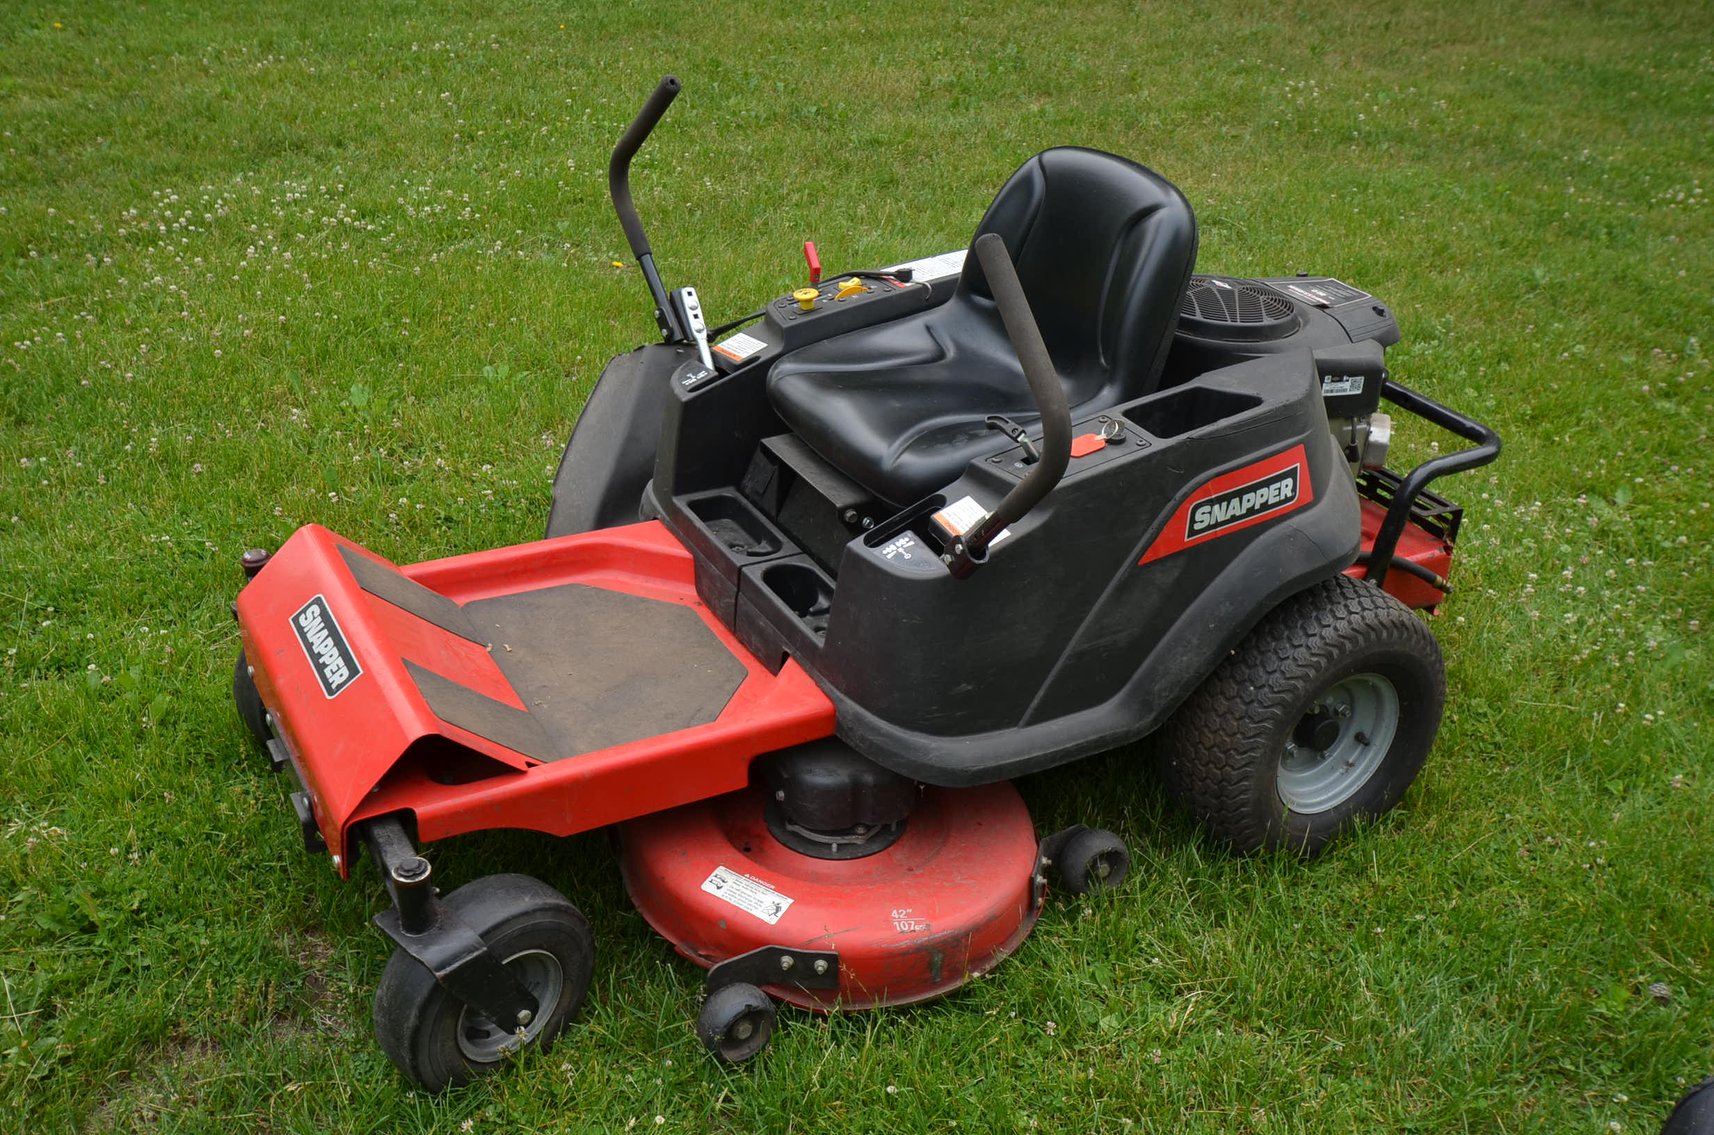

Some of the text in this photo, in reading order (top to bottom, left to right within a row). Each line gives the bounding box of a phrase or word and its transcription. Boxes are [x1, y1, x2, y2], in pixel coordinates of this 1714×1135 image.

[1193, 477, 1294, 531] SNAPPER
[298, 604, 350, 690] SNAPPER
[749, 875, 777, 890] DANGER
